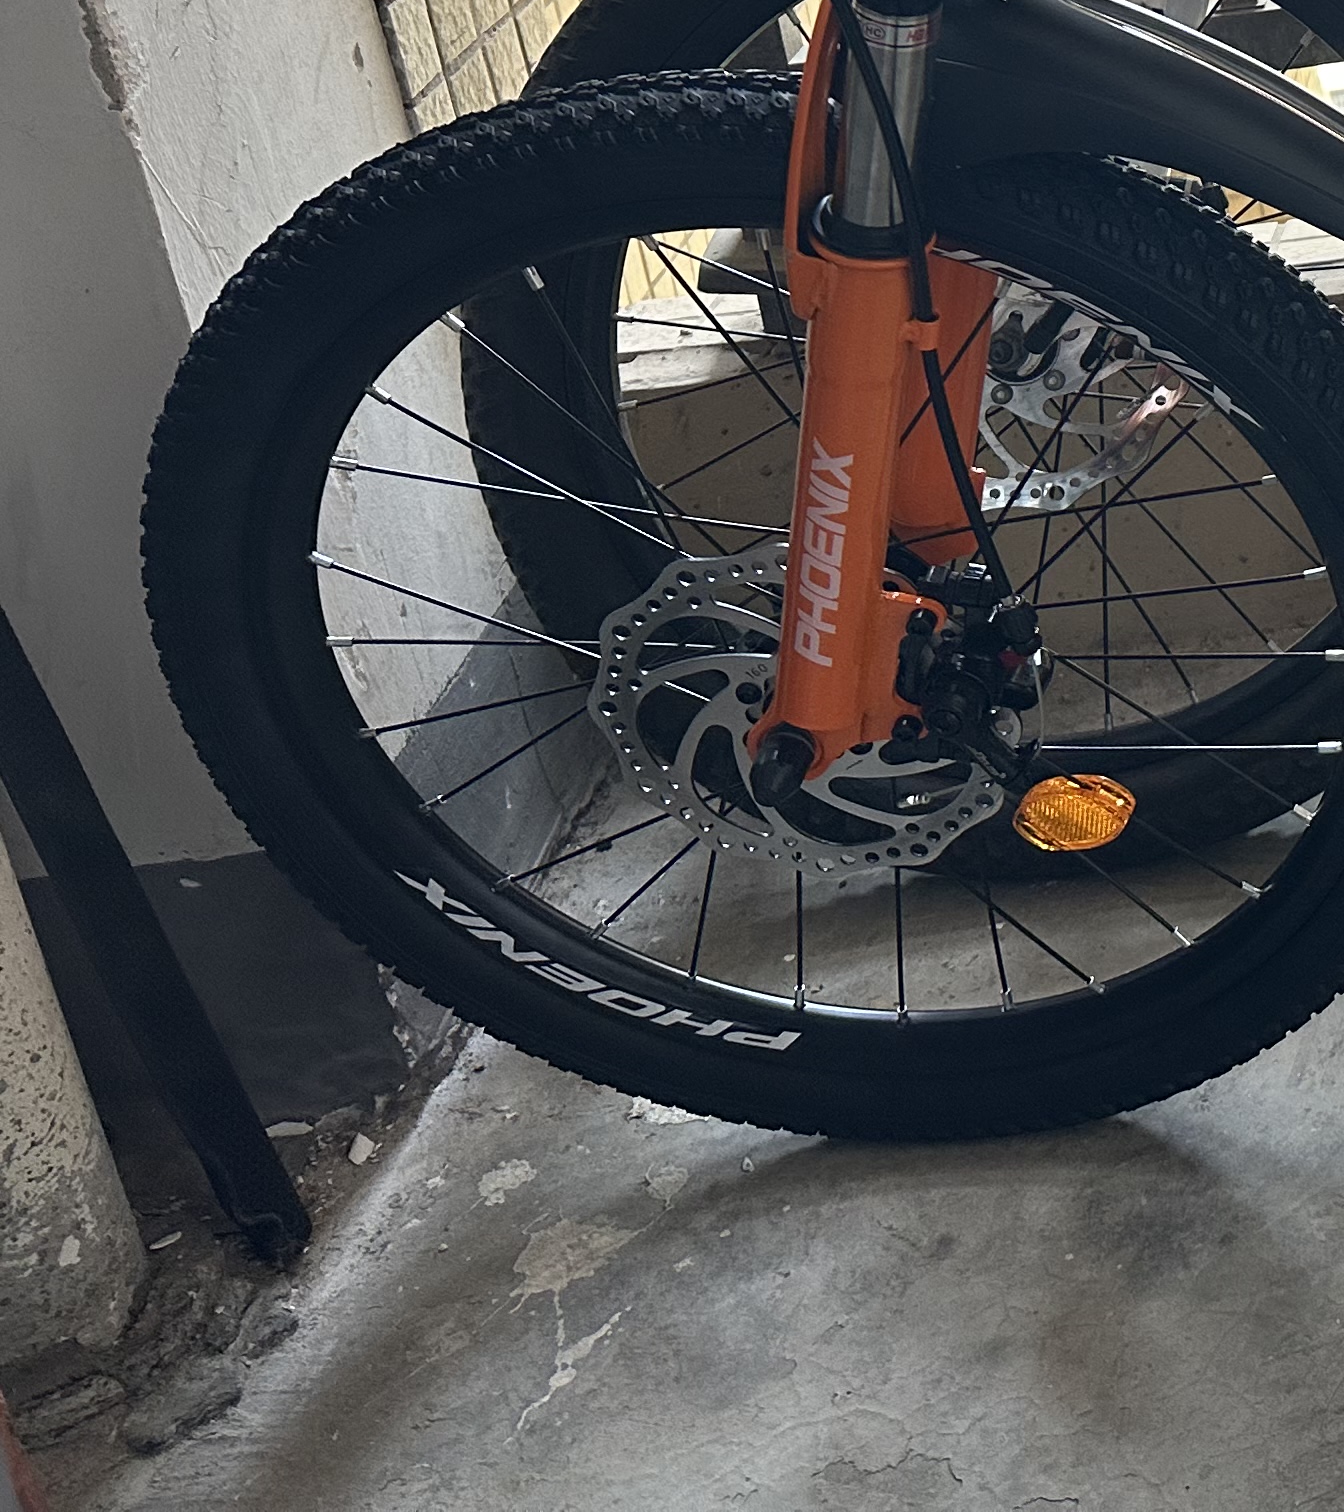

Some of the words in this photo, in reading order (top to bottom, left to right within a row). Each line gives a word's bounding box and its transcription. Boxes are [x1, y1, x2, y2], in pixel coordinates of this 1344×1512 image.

[794, 437, 854, 668] PHOENIX
[745, 663, 768, 679] 160
[393, 869, 802, 1052] PHOENIX
